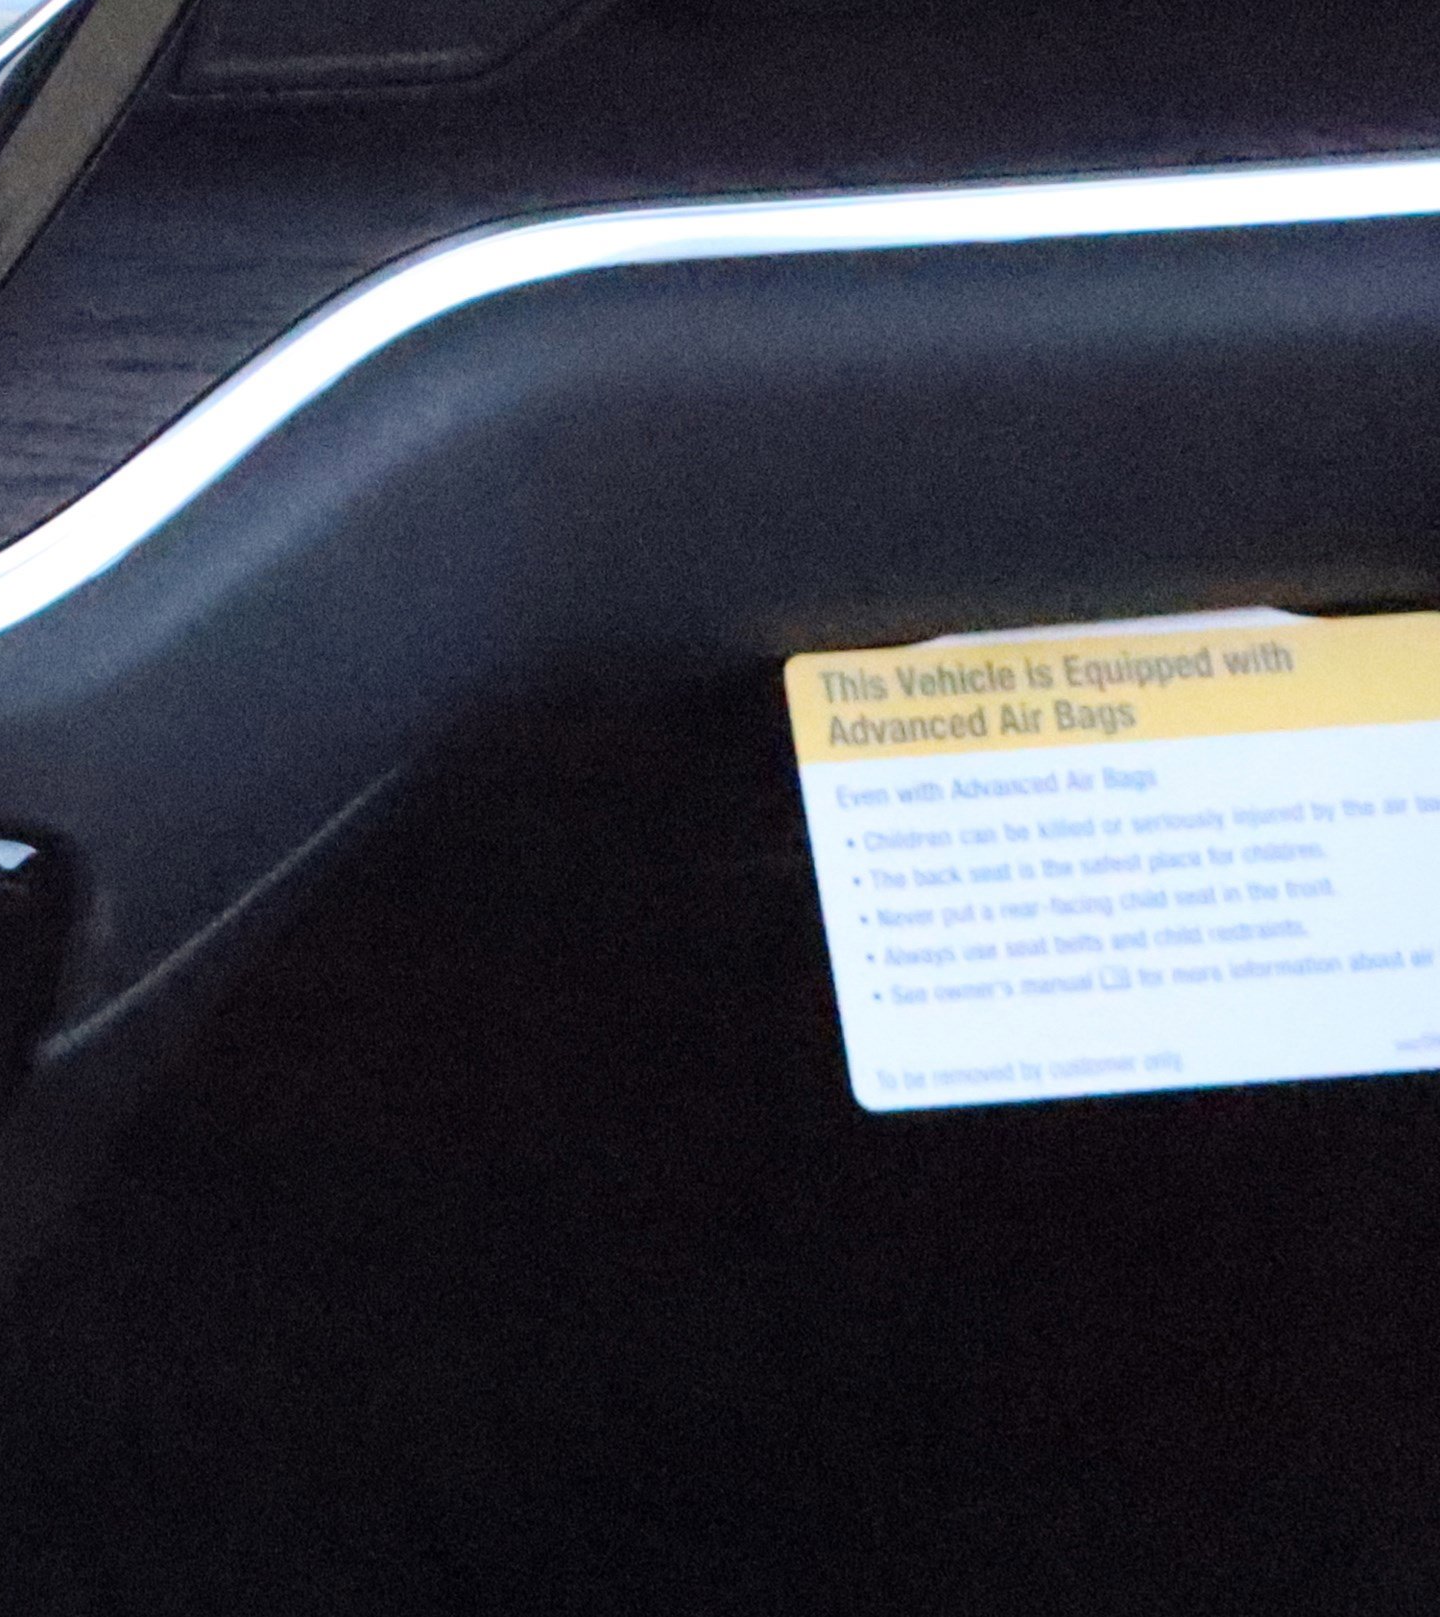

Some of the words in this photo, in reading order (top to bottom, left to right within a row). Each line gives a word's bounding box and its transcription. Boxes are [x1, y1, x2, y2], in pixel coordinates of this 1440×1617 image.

[820, 669, 888, 705] This
[898, 663, 1016, 699] Vehicle
[1026, 659, 1052, 689] is
[1064, 644, 1213, 691] Equipped
[1224, 640, 1293, 674] with
[828, 710, 988, 748] Advanced
[999, 702, 1042, 735] Air
[1055, 698, 1137, 734] Bags
